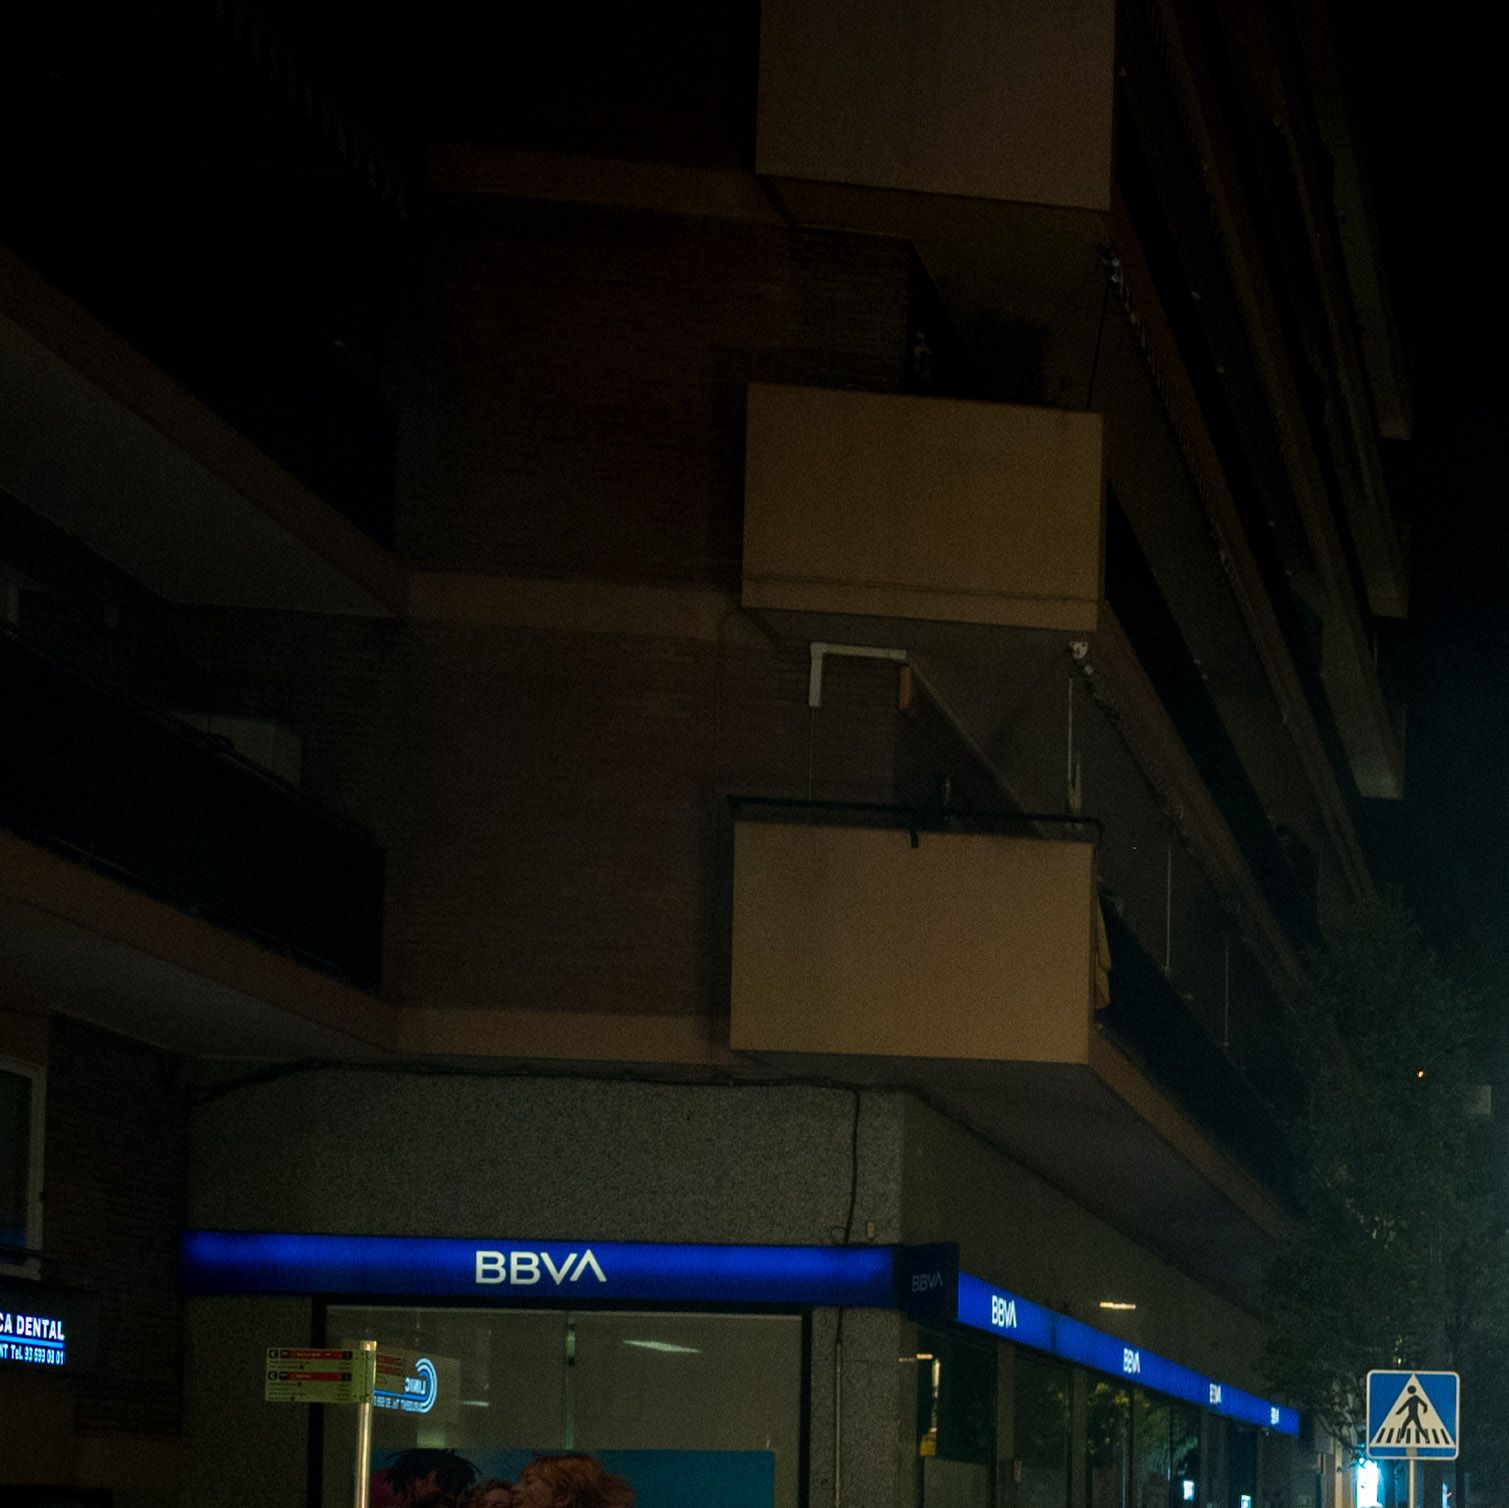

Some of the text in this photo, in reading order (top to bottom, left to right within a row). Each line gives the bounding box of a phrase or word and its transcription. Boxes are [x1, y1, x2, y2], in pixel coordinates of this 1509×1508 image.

[475, 1249, 607, 1285] BBVA
[911, 1272, 943, 1292] BBVA
[991, 1295, 1017, 1328] BBVA
[16, 1314, 65, 1341] DENTAL
[1123, 1348, 1140, 1373] BBVA
